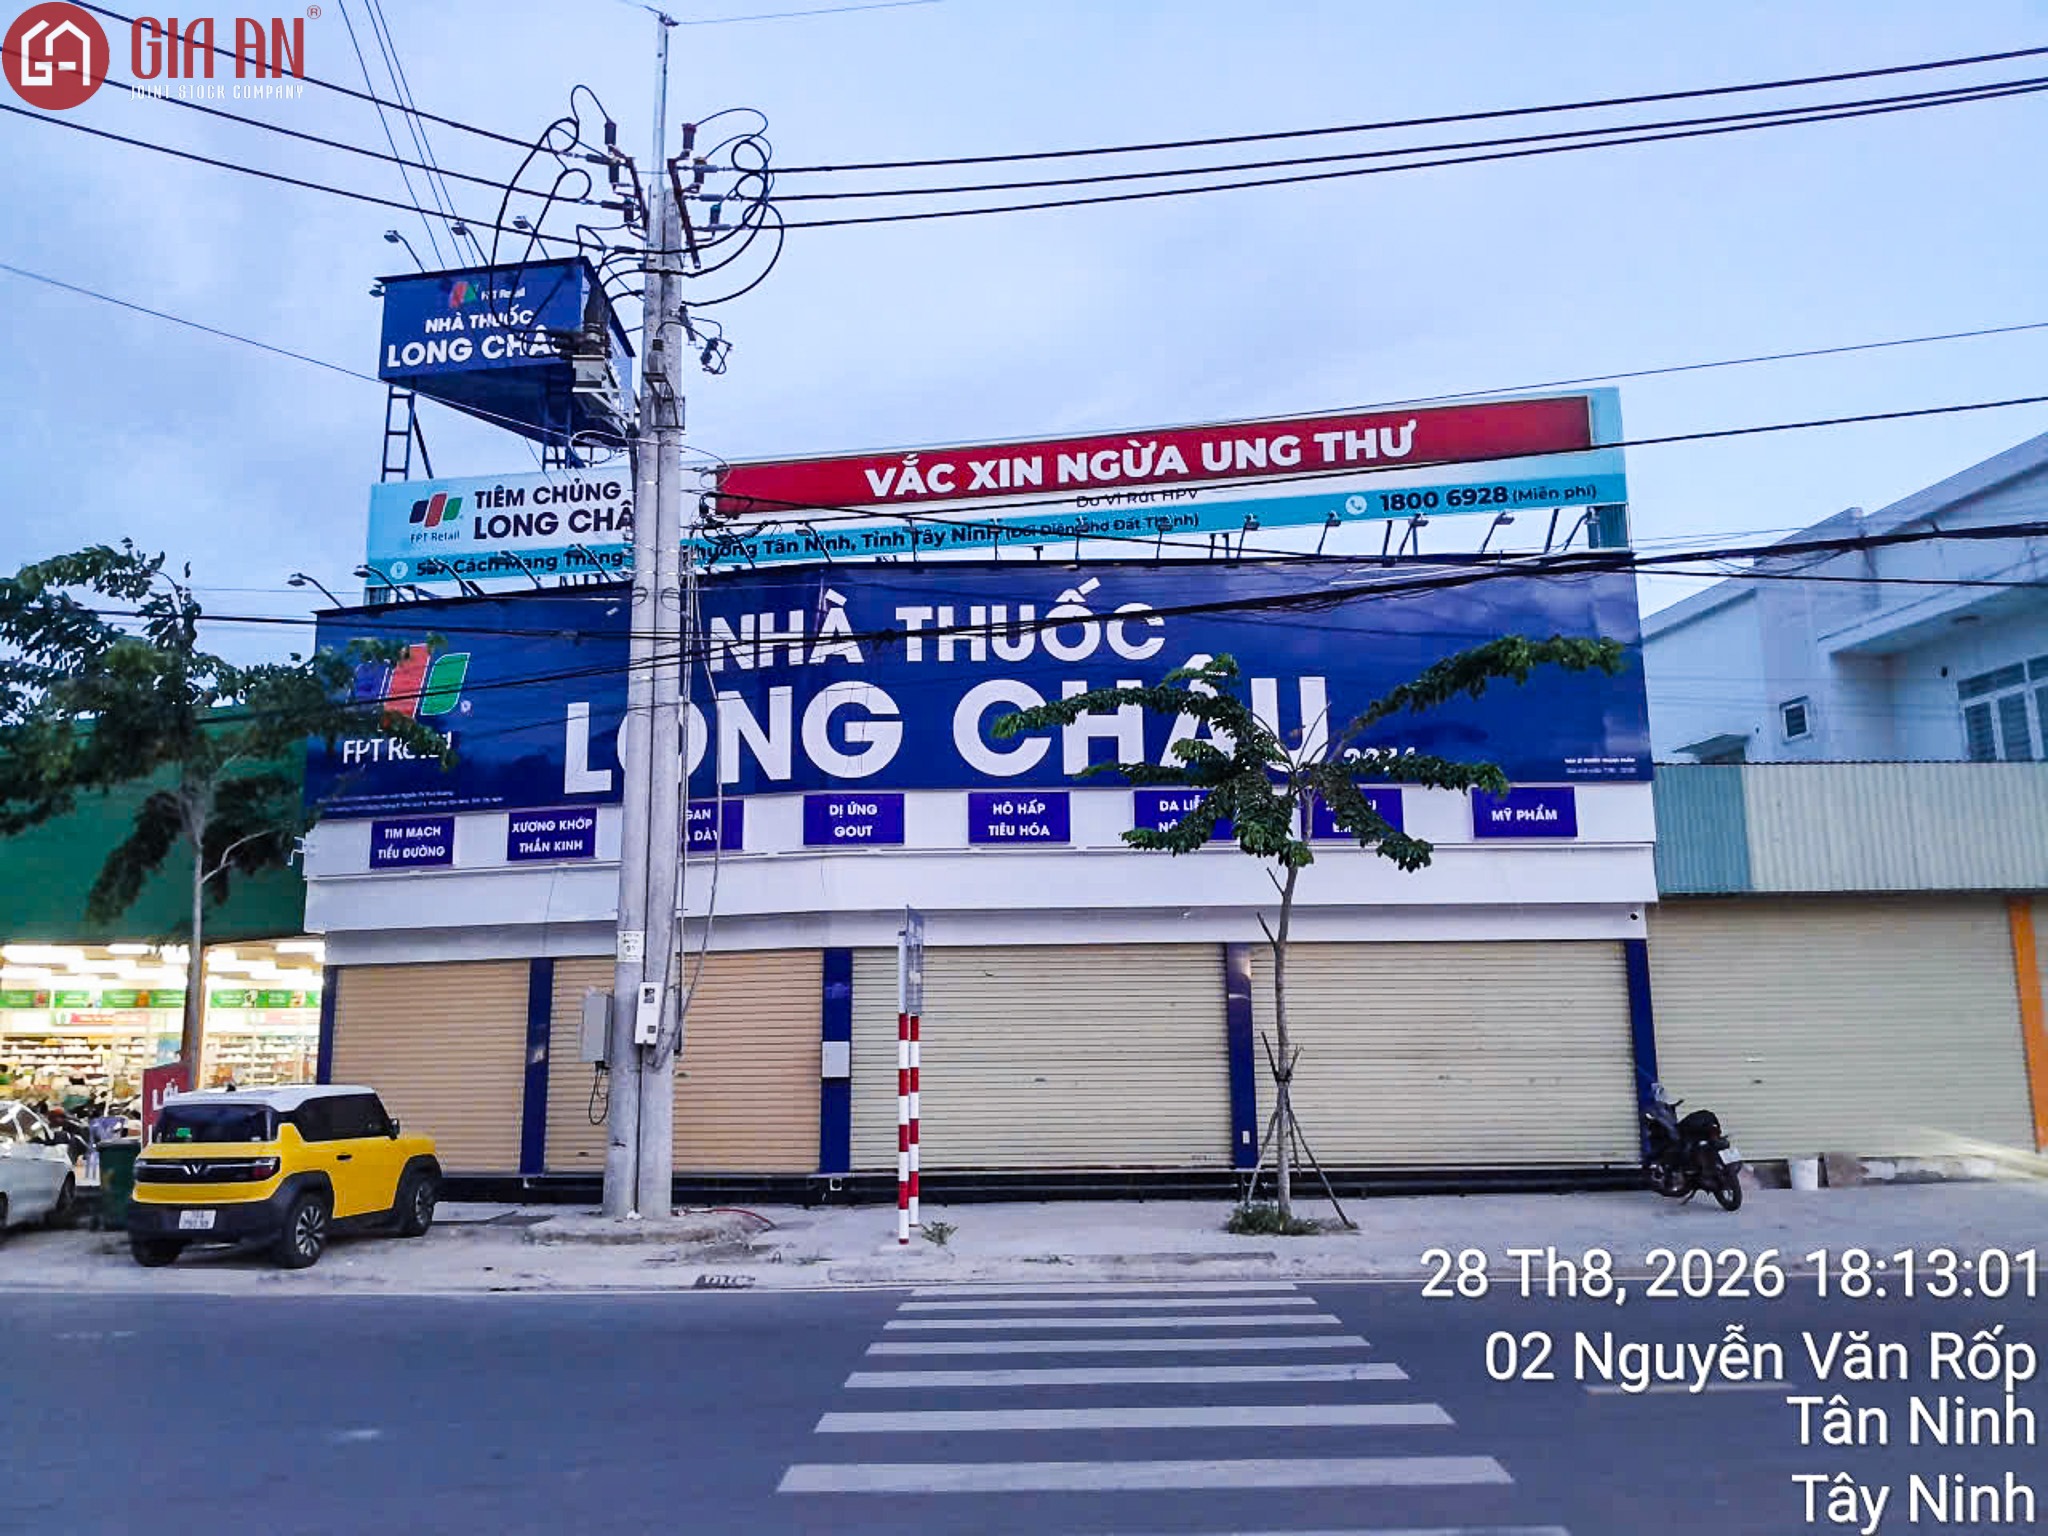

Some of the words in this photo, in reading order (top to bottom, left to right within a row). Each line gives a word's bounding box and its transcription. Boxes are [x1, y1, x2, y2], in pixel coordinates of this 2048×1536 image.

[424, 312, 464, 334] NHÀ
[469, 304, 534, 329] THUỐC
[387, 338, 473, 368] LONG
[865, 453, 956, 498] VẮC
[967, 456, 1043, 490] XIN
[1057, 439, 1189, 483] NGỪA
[1201, 434, 1301, 472] UNG
[1314, 418, 1418, 462] THƯ
[474, 486, 525, 510] TIÊM
[532, 479, 622, 506] CHỦNG
[1380, 491, 1439, 511] 1800
[1447, 486, 1508, 507] 6928
[474, 510, 559, 541] LONG
[568, 500, 634, 535] CHÂ
[709, 588, 864, 672] NHÀ
[895, 577, 1166, 662] THUỐC
[343, 738, 385, 764] FPT
[829, 804, 843, 818] DỊ
[847, 802, 878, 816] ỨNG
[993, 803, 1014, 815] HÔ
[1017, 799, 1046, 815] HẤP
[1159, 800, 1180, 811] DA
[1492, 807, 1512, 822] MỸ
[1516, 803, 1558, 821] PHẨM
[385, 828, 402, 839] TIM
[406, 826, 441, 841] MẠCH
[512, 820, 555, 833] XƯƠNG
[560, 817, 593, 831] KHỚP
[834, 825, 873, 837] GOUT
[988, 822, 1015, 836] TIÊU
[1019, 820, 1050, 836] HÓA
[519, 838, 550, 853] THẦN
[554, 840, 583, 851] KINH
